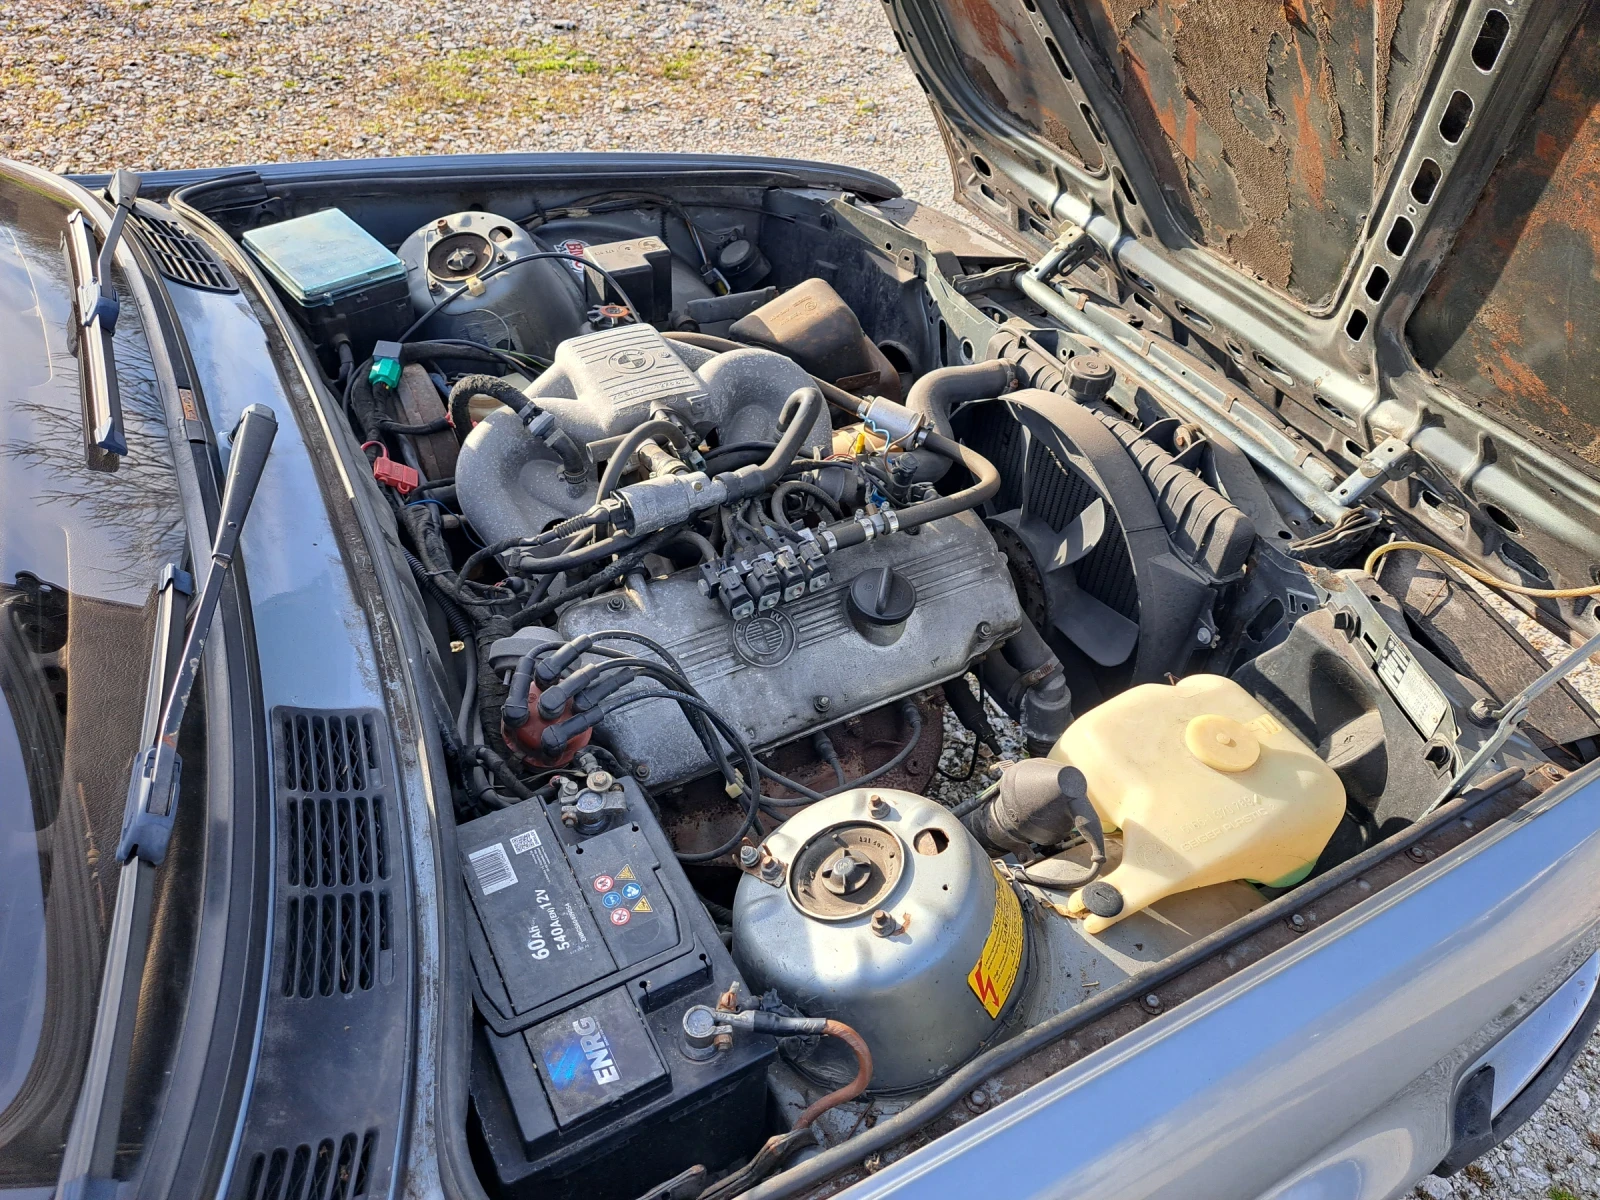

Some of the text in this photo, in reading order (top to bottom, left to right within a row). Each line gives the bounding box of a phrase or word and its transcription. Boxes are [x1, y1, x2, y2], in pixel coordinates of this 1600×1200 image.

[1180, 829, 1223, 851] GEIGER
[1223, 807, 1268, 831] PLASTIC
[527, 925, 550, 960] 60Ah
[572, 1016, 621, 1086] ENRG
